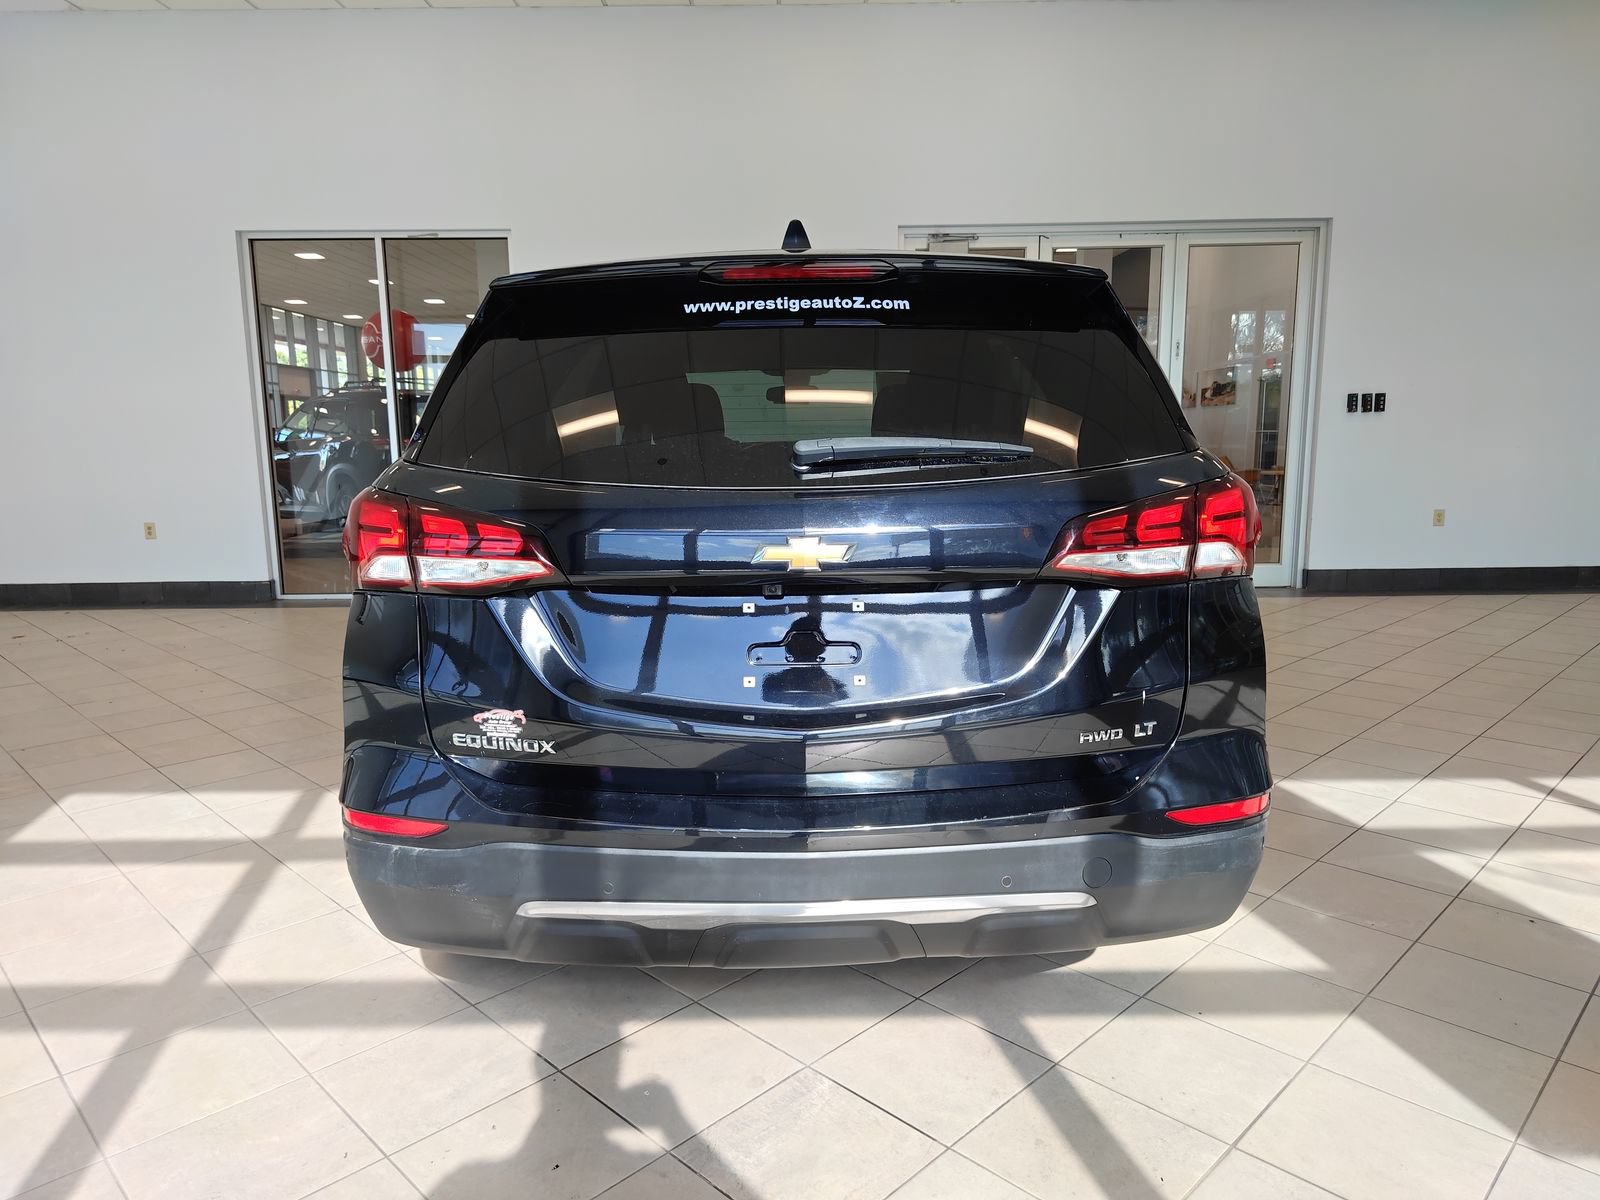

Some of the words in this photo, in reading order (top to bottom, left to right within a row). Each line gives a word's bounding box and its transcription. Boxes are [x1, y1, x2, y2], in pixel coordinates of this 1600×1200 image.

[684, 296, 910, 313] www.prestigeautoZ.com
[1079, 728, 1123, 743] AWD
[1134, 721, 1157, 737] LT
[452, 733, 556, 754] EQUINOX
